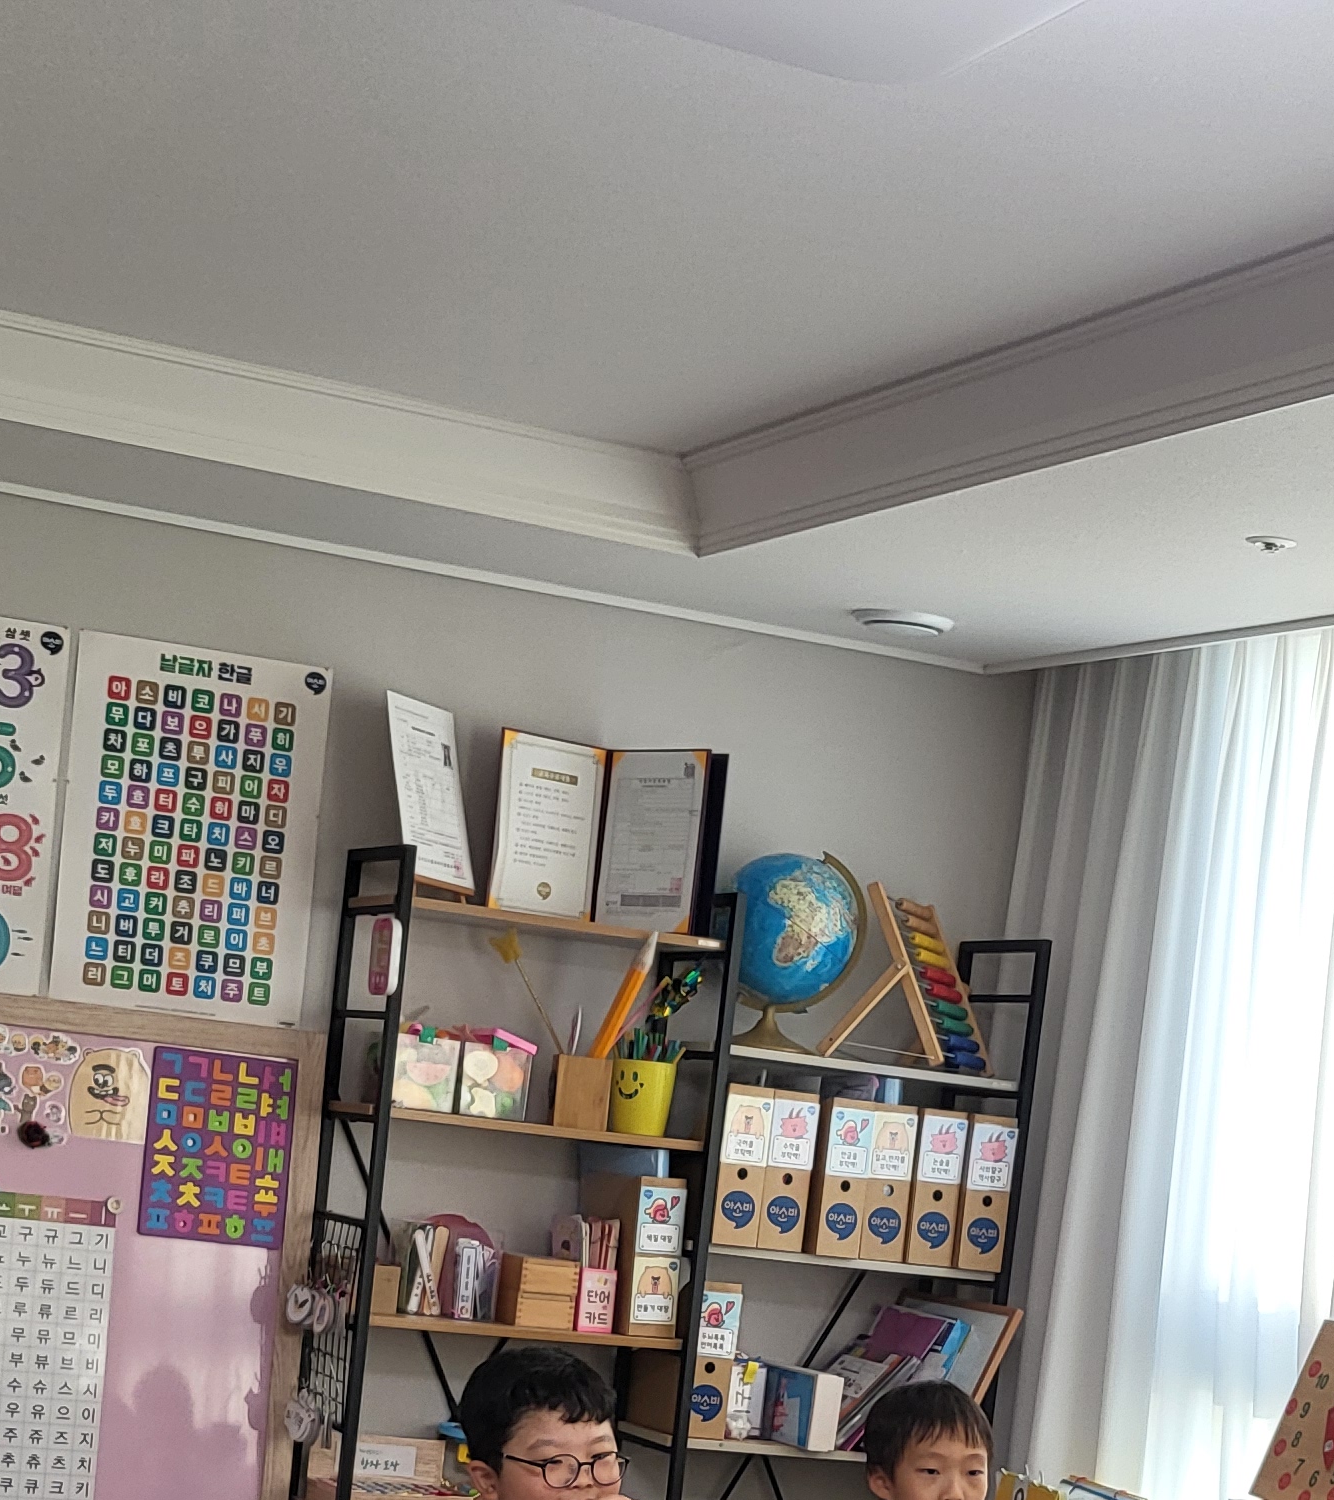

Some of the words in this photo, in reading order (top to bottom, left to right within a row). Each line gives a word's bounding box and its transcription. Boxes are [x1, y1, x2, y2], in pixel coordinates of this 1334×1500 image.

[217, 661, 253, 685] 한글
[112, 682, 125, 697] 아
[140, 686, 154, 700] 소
[169, 690, 181, 705] 비
[195, 695, 210, 708] 코
[224, 698, 236, 713] 나
[279, 707, 292, 722] 기
[19, 1227, 33, 1241] 구
[44, 1229, 58, 1244] 규
[70, 1232, 84, 1245] 그
[95, 1234, 109, 1248] 기
[586, 1290, 610, 1305] 단어
[584, 1311, 608, 1326] 카드
[1315, 1373, 1330, 1390] 10
[1299, 1401, 1311, 1419] 9
[1290, 1430, 1303, 1448] 8
[1293, 1458, 1306, 1476] 7
[1308, 1470, 1320, 1488] 6
